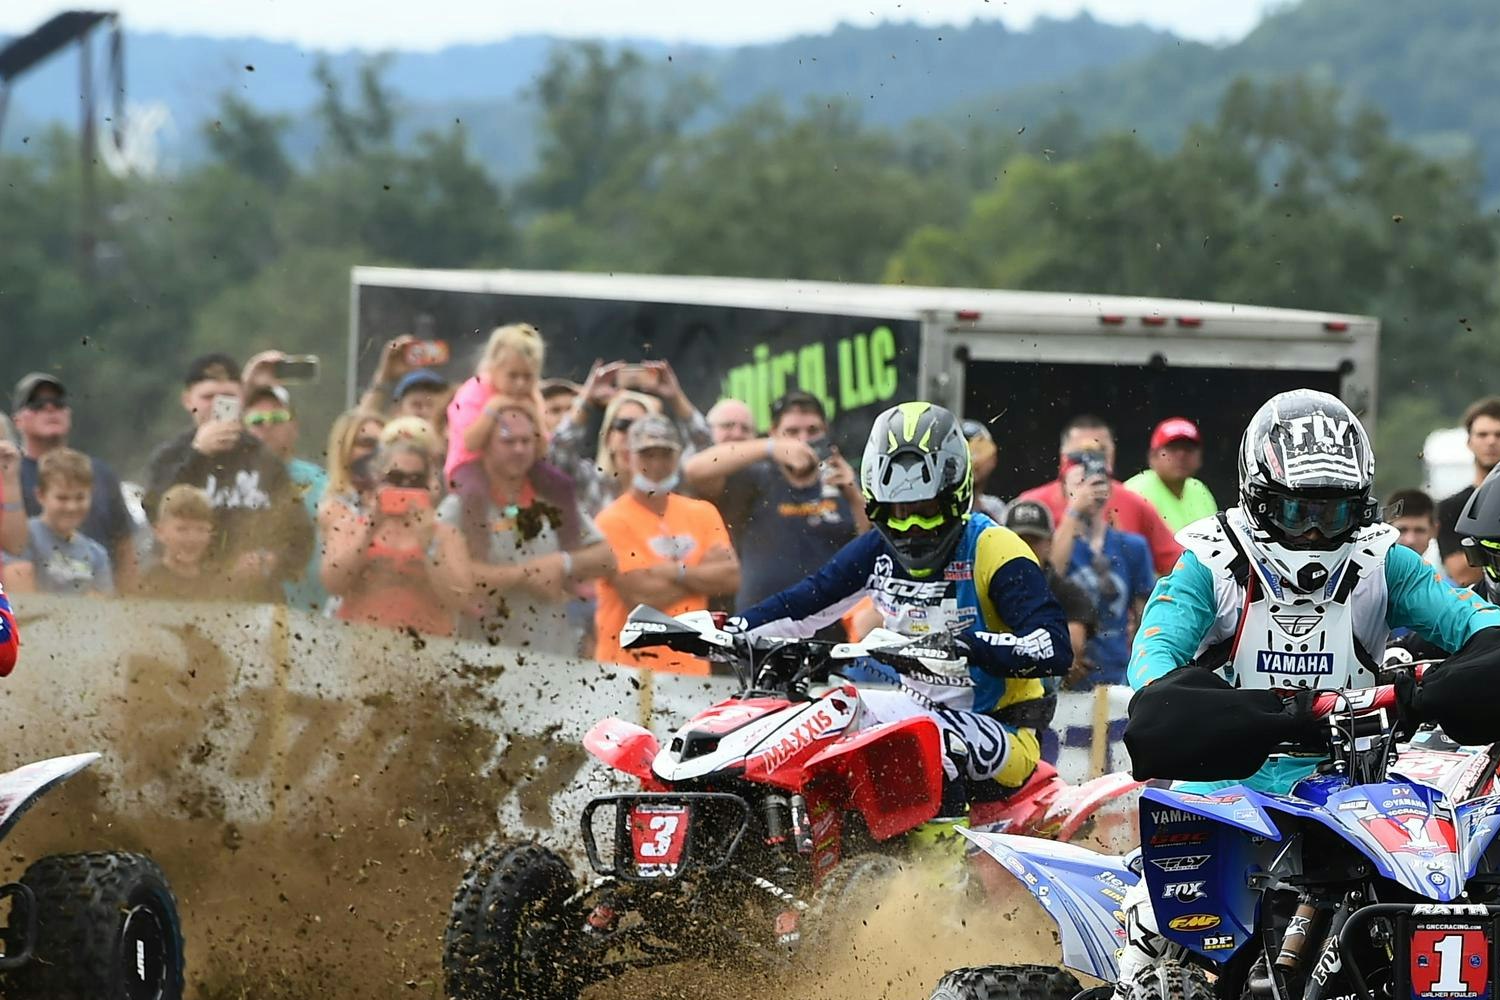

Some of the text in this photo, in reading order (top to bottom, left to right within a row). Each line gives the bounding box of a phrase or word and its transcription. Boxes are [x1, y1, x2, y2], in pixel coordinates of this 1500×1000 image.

[838, 326, 898, 410] LLC
[1289, 411, 1349, 447] FLY
[1262, 653, 1329, 672] YAMAHA
[911, 670, 976, 687] HONDA
[761, 710, 833, 775] MAXXIS
[1152, 810, 1206, 824] YAMA
[640, 816, 679, 857] 3
[1163, 881, 1208, 901] FOX
[1412, 903, 1489, 916] RATH
[1204, 936, 1233, 945] DP
[1431, 935, 1467, 991] 1
